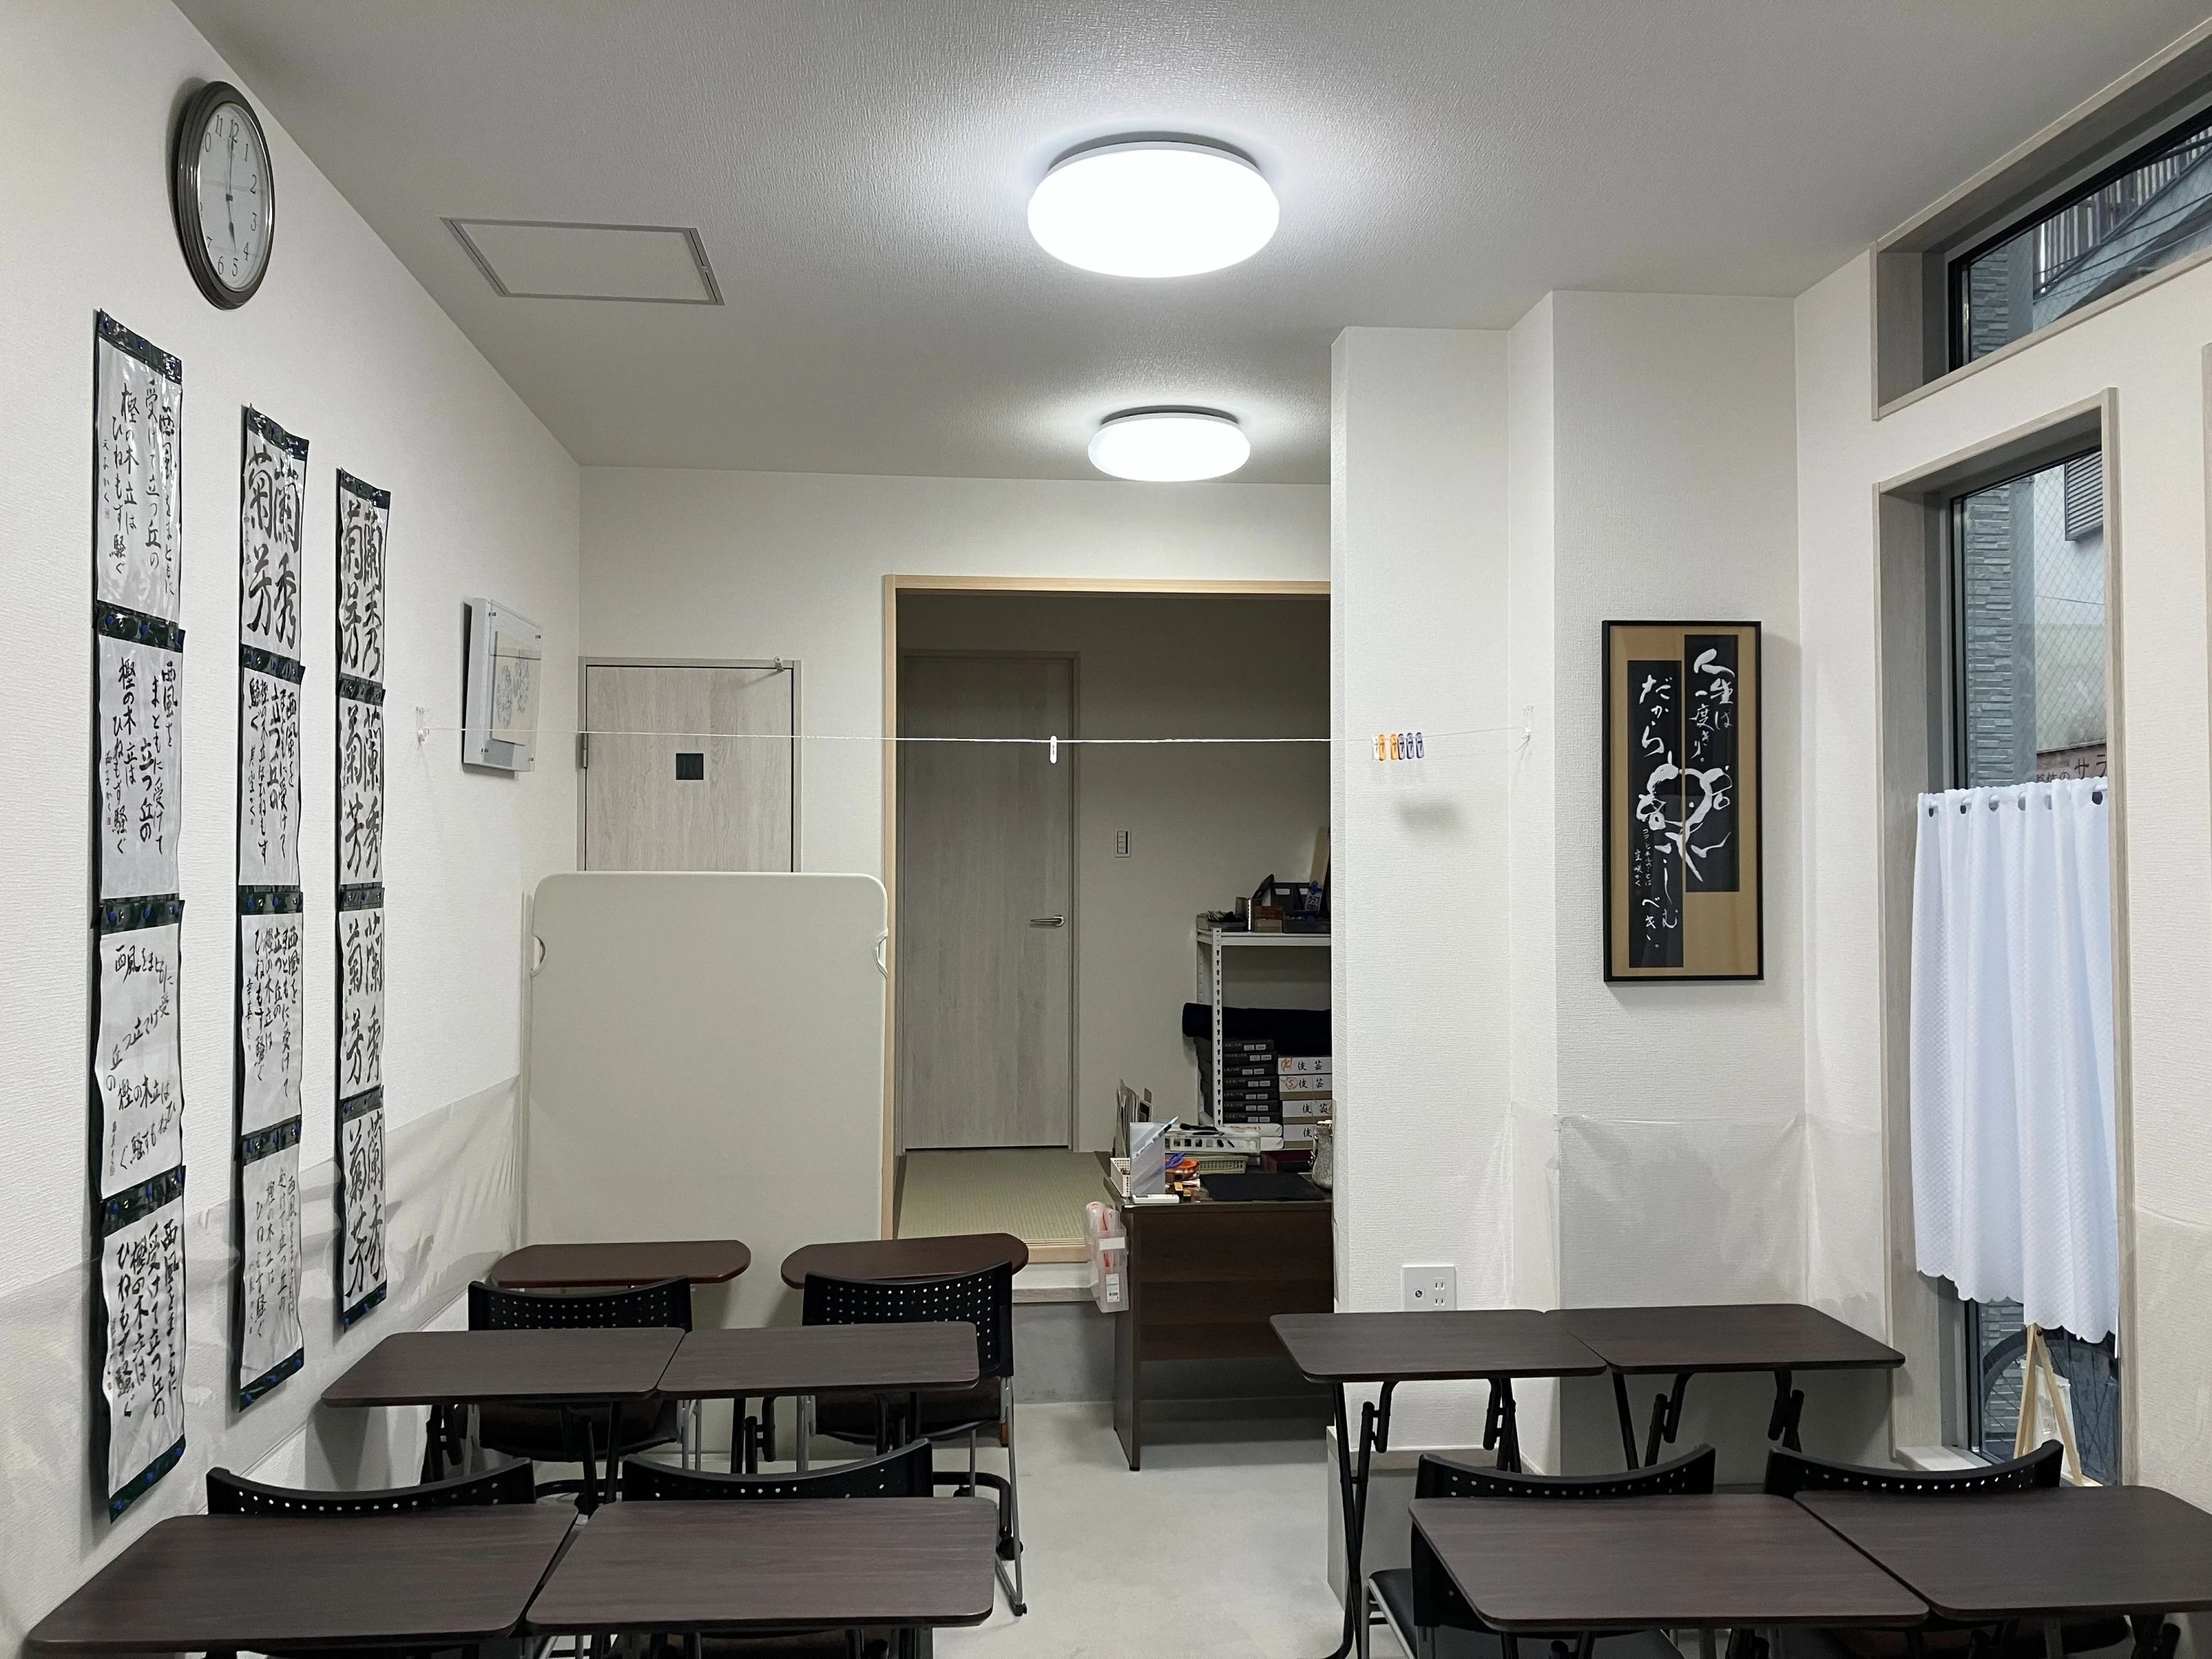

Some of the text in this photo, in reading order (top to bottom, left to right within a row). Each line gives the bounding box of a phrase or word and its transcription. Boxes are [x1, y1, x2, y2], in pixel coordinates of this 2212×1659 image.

[215, 114, 223, 138] 11
[229, 119, 240, 143] 12
[243, 143, 249, 161] 1
[249, 174, 258, 194] 2
[250, 212, 259, 232] 3
[242, 241, 250, 262] 4
[218, 256, 224, 275] 6
[231, 257, 239, 277] 5
[1693, 648, 1736, 731] 人生は
